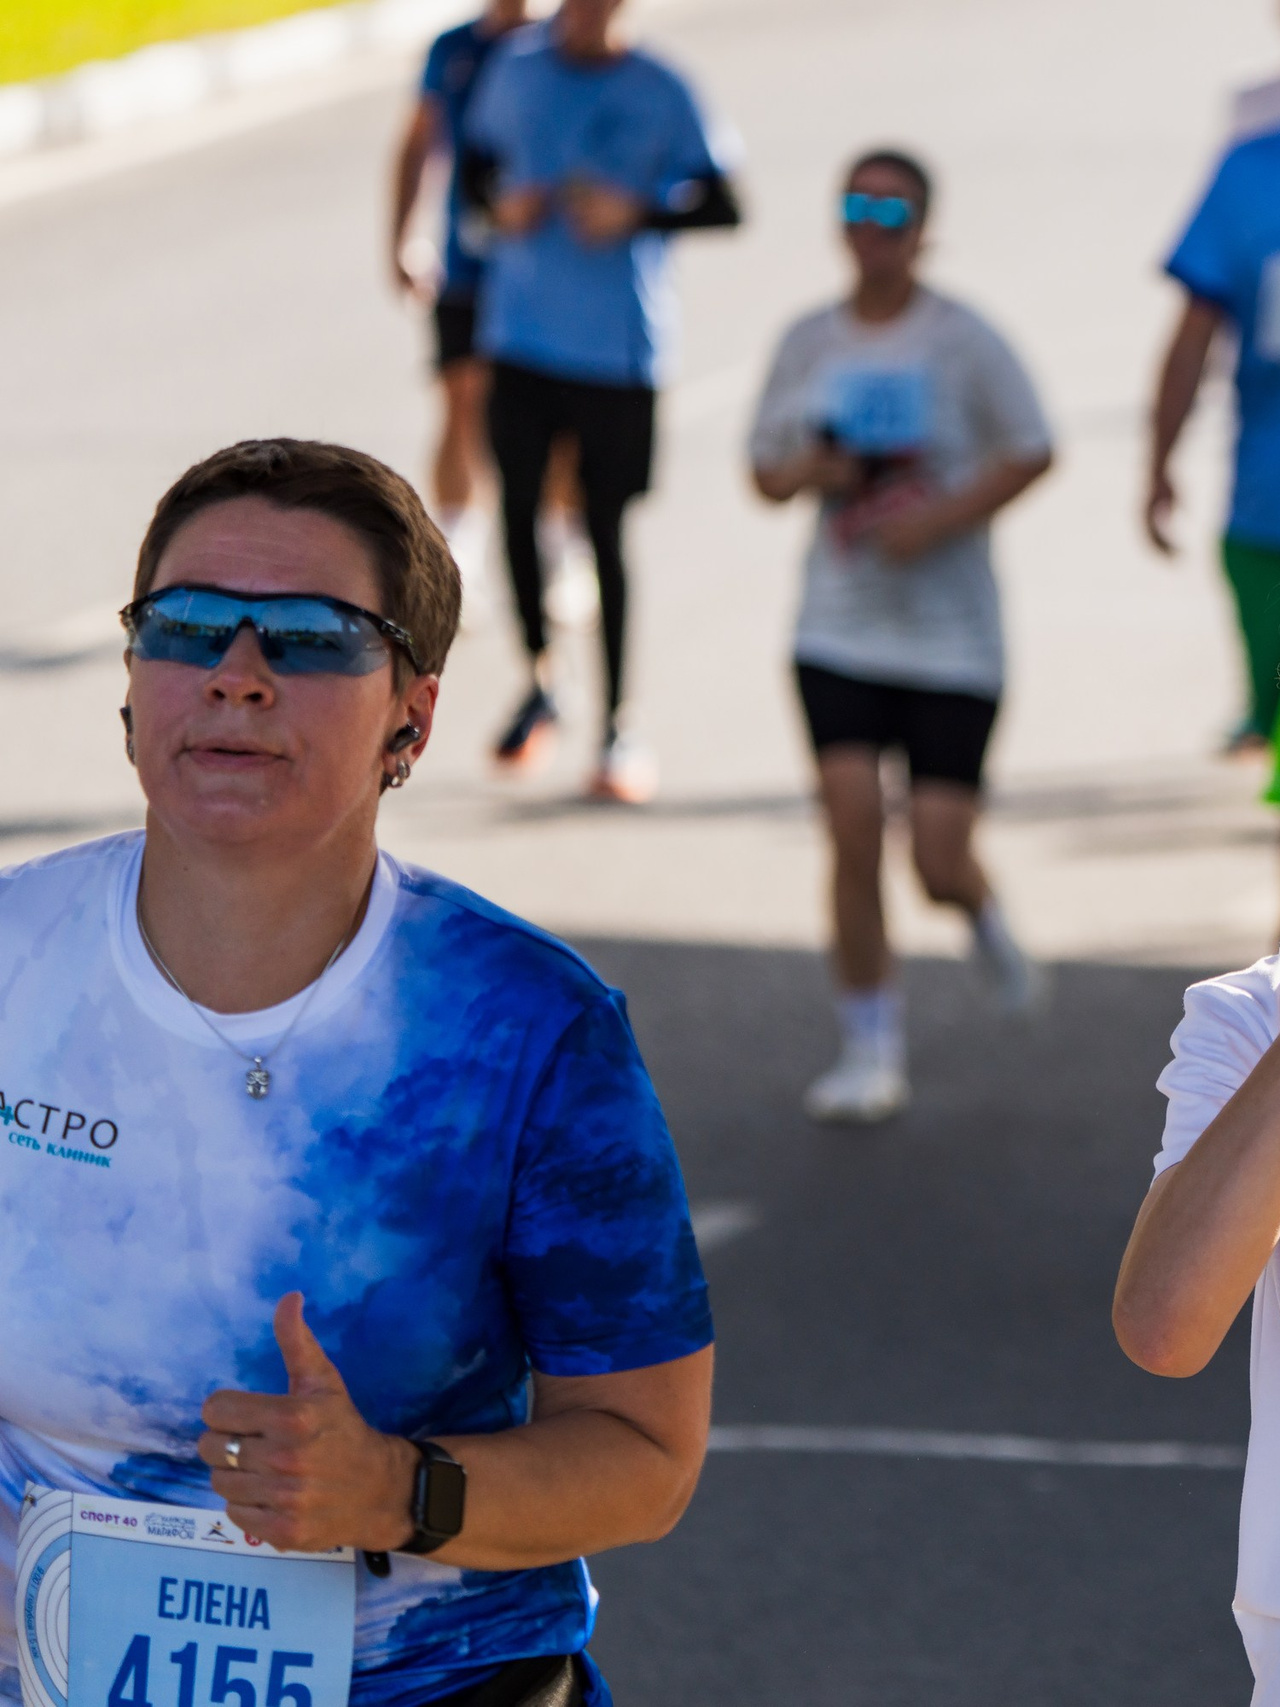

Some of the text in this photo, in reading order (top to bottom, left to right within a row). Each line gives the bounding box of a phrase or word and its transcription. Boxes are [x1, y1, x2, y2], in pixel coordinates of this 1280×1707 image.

[80, 1510, 138, 1528] СПОРТ 40
[158, 1576, 271, 1631] ЕЛЕНА
[107, 1633, 315, 1707] 4155
